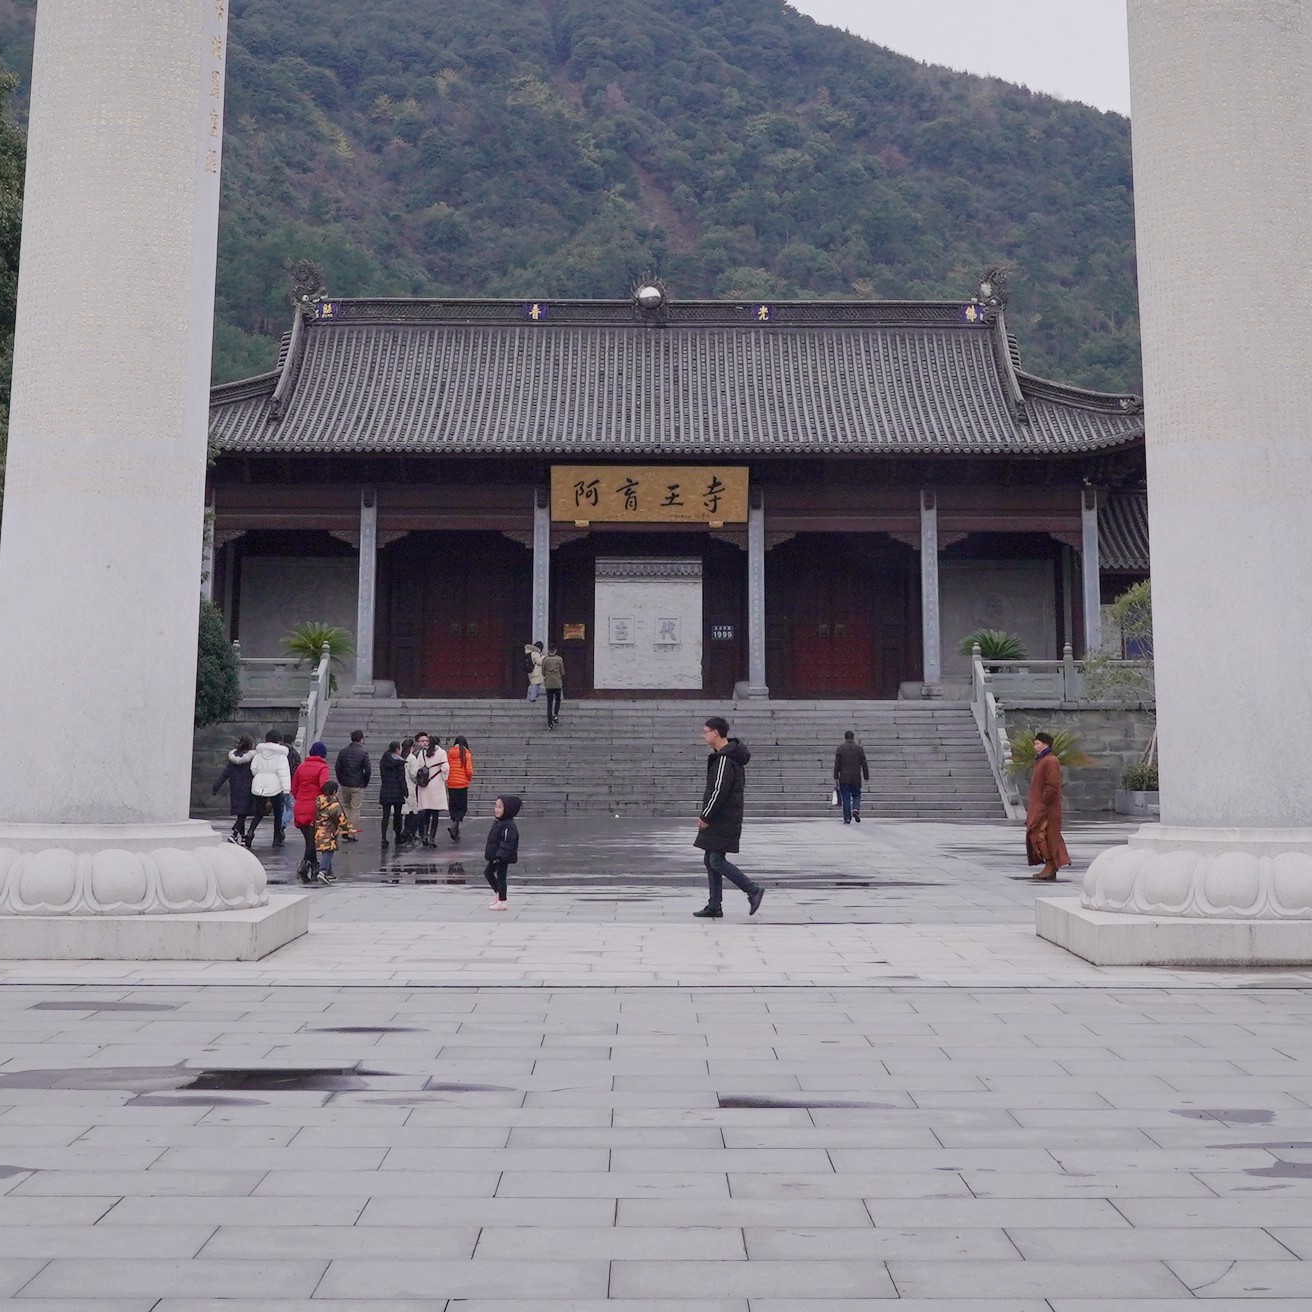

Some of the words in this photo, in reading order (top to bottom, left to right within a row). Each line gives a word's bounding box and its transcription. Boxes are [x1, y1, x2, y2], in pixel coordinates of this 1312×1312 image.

[758, 305, 768, 320] 光
[574, 475, 726, 513] 阿育王寺
